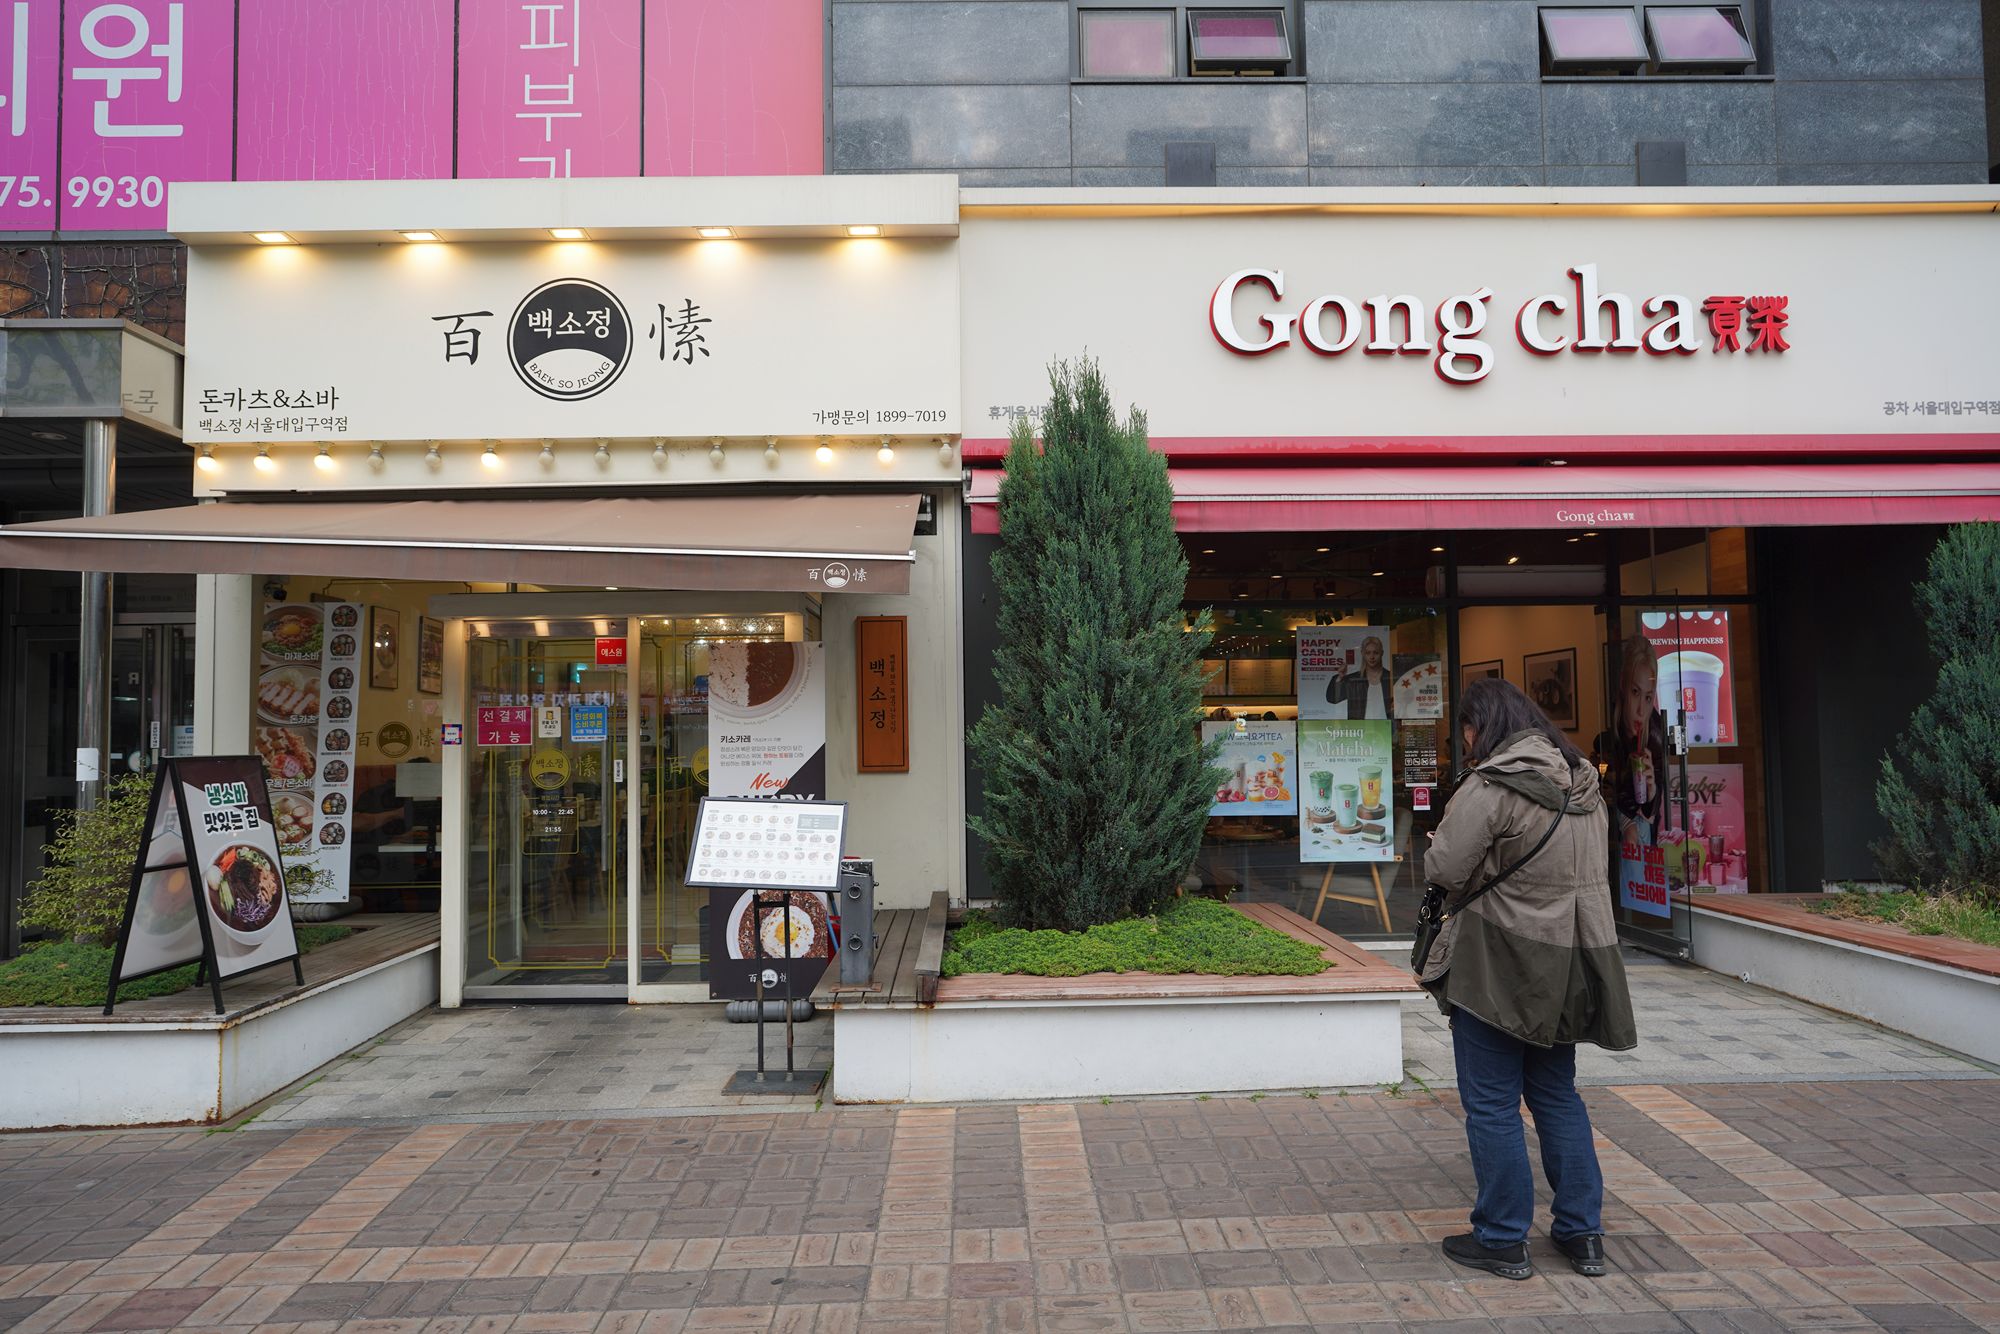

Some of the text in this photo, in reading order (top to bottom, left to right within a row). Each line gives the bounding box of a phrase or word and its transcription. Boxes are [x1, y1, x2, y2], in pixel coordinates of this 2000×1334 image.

[67, 175, 164, 208] 9930
[527, 307, 611, 339] 백소정
[1209, 262, 1703, 385] Gong cha
[431, 311, 494, 365] 百
[529, 361, 611, 389] BAEK SO JEONG
[199, 386, 339, 413] 돈카츠&소바
[1883, 401, 1909, 415] 공차
[199, 416, 348, 434] 백소정 서울대입구역점
[812, 409, 946, 425] 가맹문의 1899-7019
[1556, 509, 1622, 525] Gong cha
[1301, 639, 1341, 647] HAPPY
[1684, 637, 1724, 645] HAPPINESS
[1301, 648, 1334, 656] CARD
[1301, 658, 1344, 666] SERIES
[870, 658, 886, 729] 백소정
[1325, 726, 1363, 740] Spring
[1316, 741, 1373, 757] Matcha
[536, 758, 564, 769] 백소정
[750, 773, 789, 790] New
[206, 785, 248, 805] 냉소바
[204, 809, 259, 832] 맛있는 집
